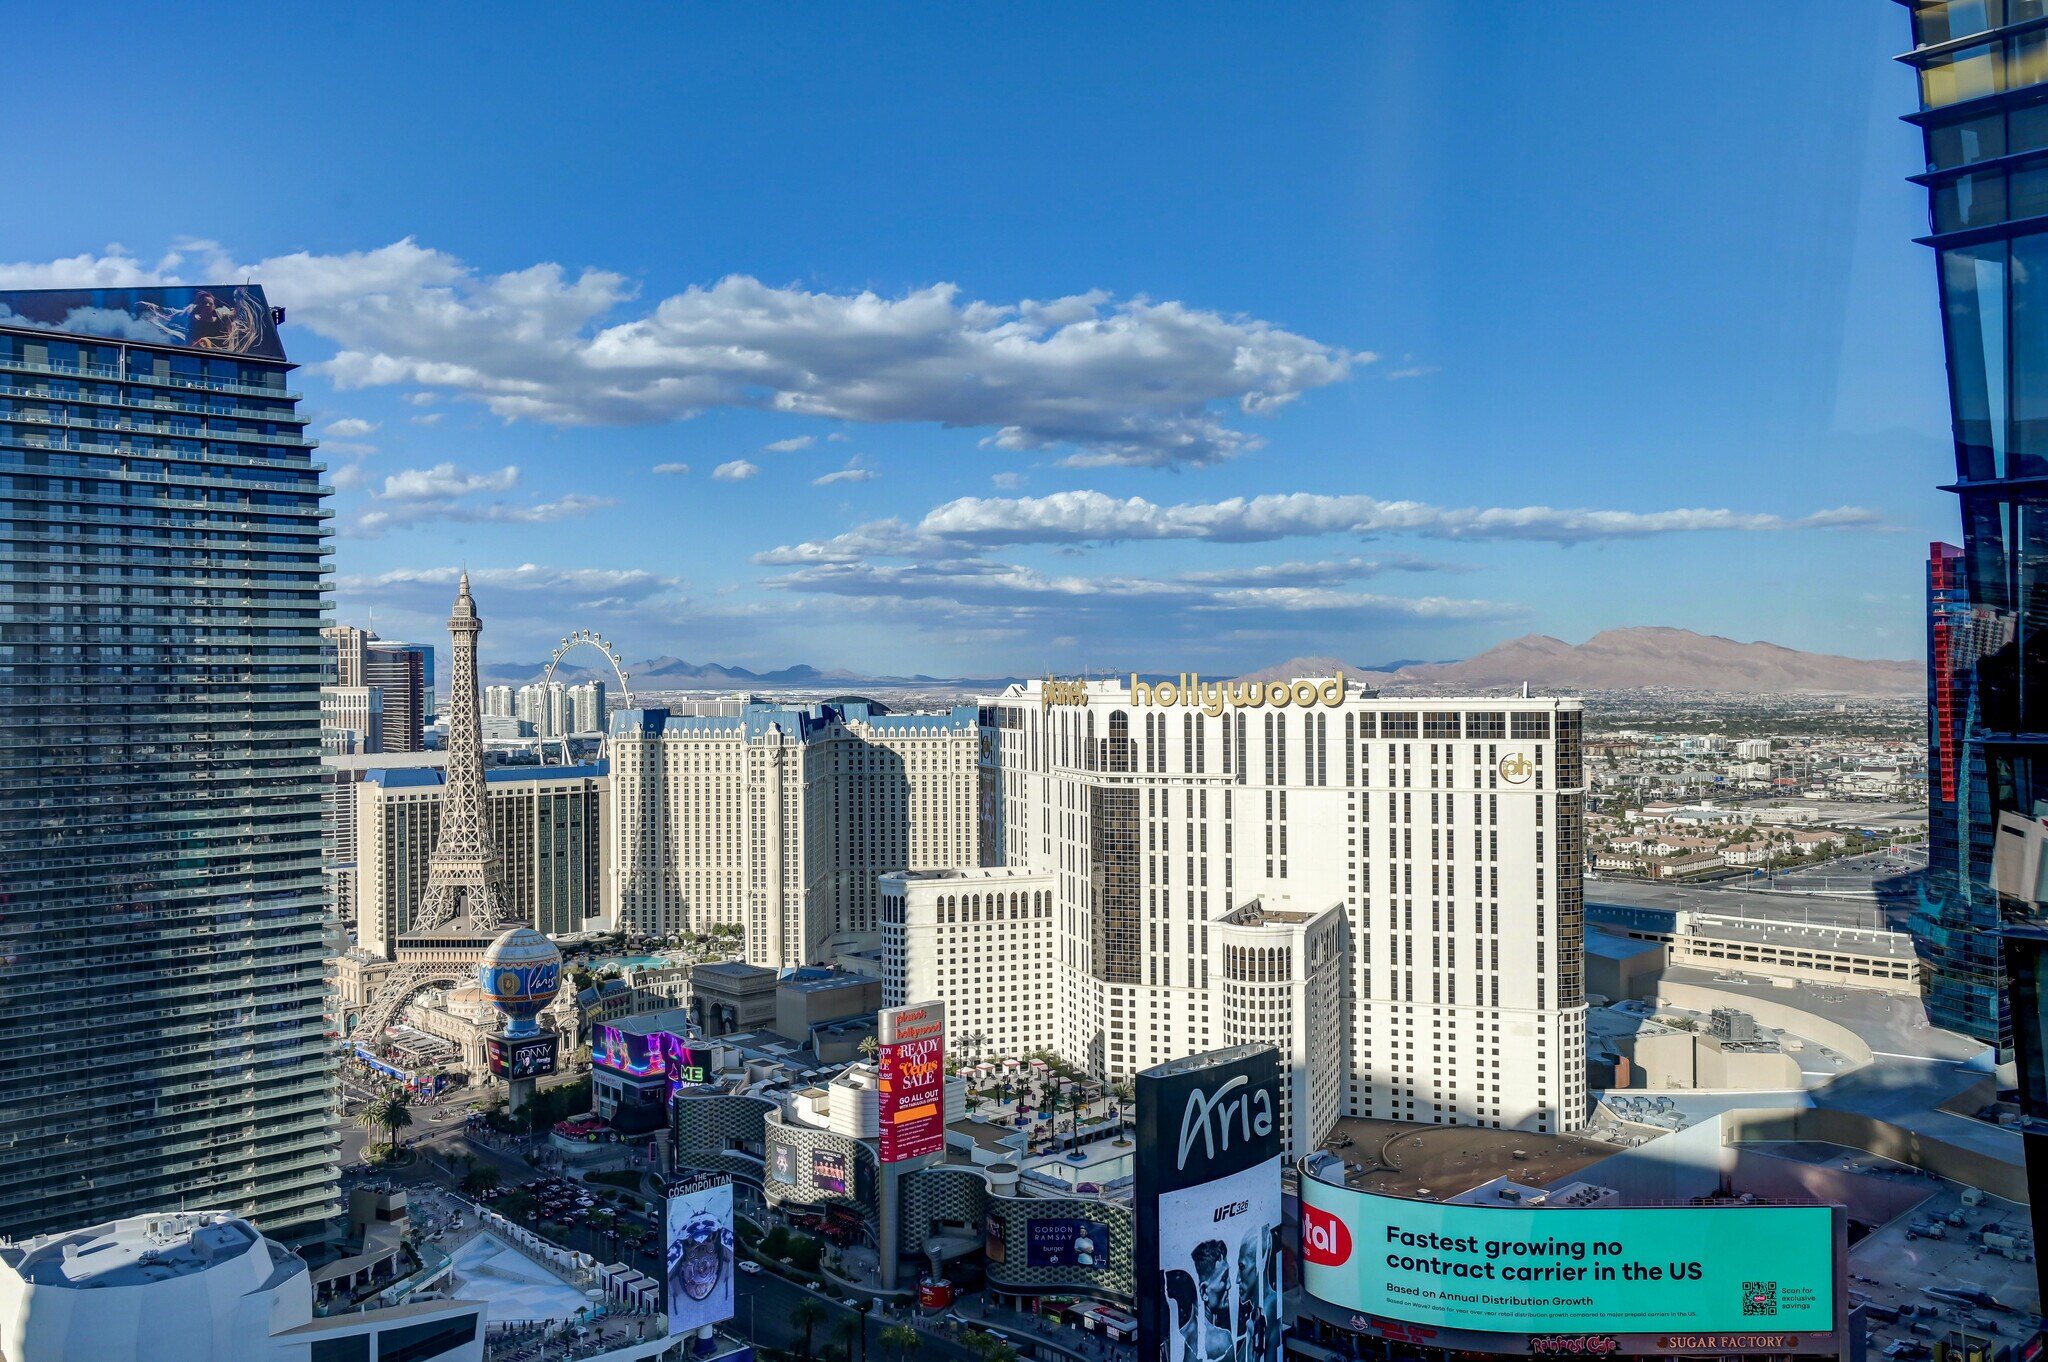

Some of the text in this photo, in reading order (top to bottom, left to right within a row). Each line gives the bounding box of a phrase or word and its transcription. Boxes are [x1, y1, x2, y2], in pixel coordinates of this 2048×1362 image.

[1042, 671, 1344, 717] planet hollywood
[1502, 753, 1532, 779] ph
[528, 962, 556, 1000] Paris
[896, 1009, 927, 1027] planet
[896, 1020, 942, 1039] hollywood
[516, 1045, 551, 1062] DONNY
[910, 1053, 928, 1067] TO
[681, 1065, 703, 1081] ME
[899, 1060, 938, 1078] Vegas
[903, 1071, 934, 1089] SALE
[899, 1089, 938, 1105] GO ALL OUT
[1177, 1075, 1272, 1171] Aria
[668, 1174, 732, 1198] COSMOPOLITAN
[694, 1173, 707, 1181] THE
[1213, 1200, 1248, 1222] UFC 326
[1387, 1226, 1622, 1260] Fastest growing no
[1386, 1254, 1702, 1280] contract carrier in the US
[1386, 1283, 1593, 1305] Based on Annual Distribution Growth
[1531, 1336, 1586, 1354] Rainforest
[1669, 1336, 1784, 1348] SUGAR FACTORY
